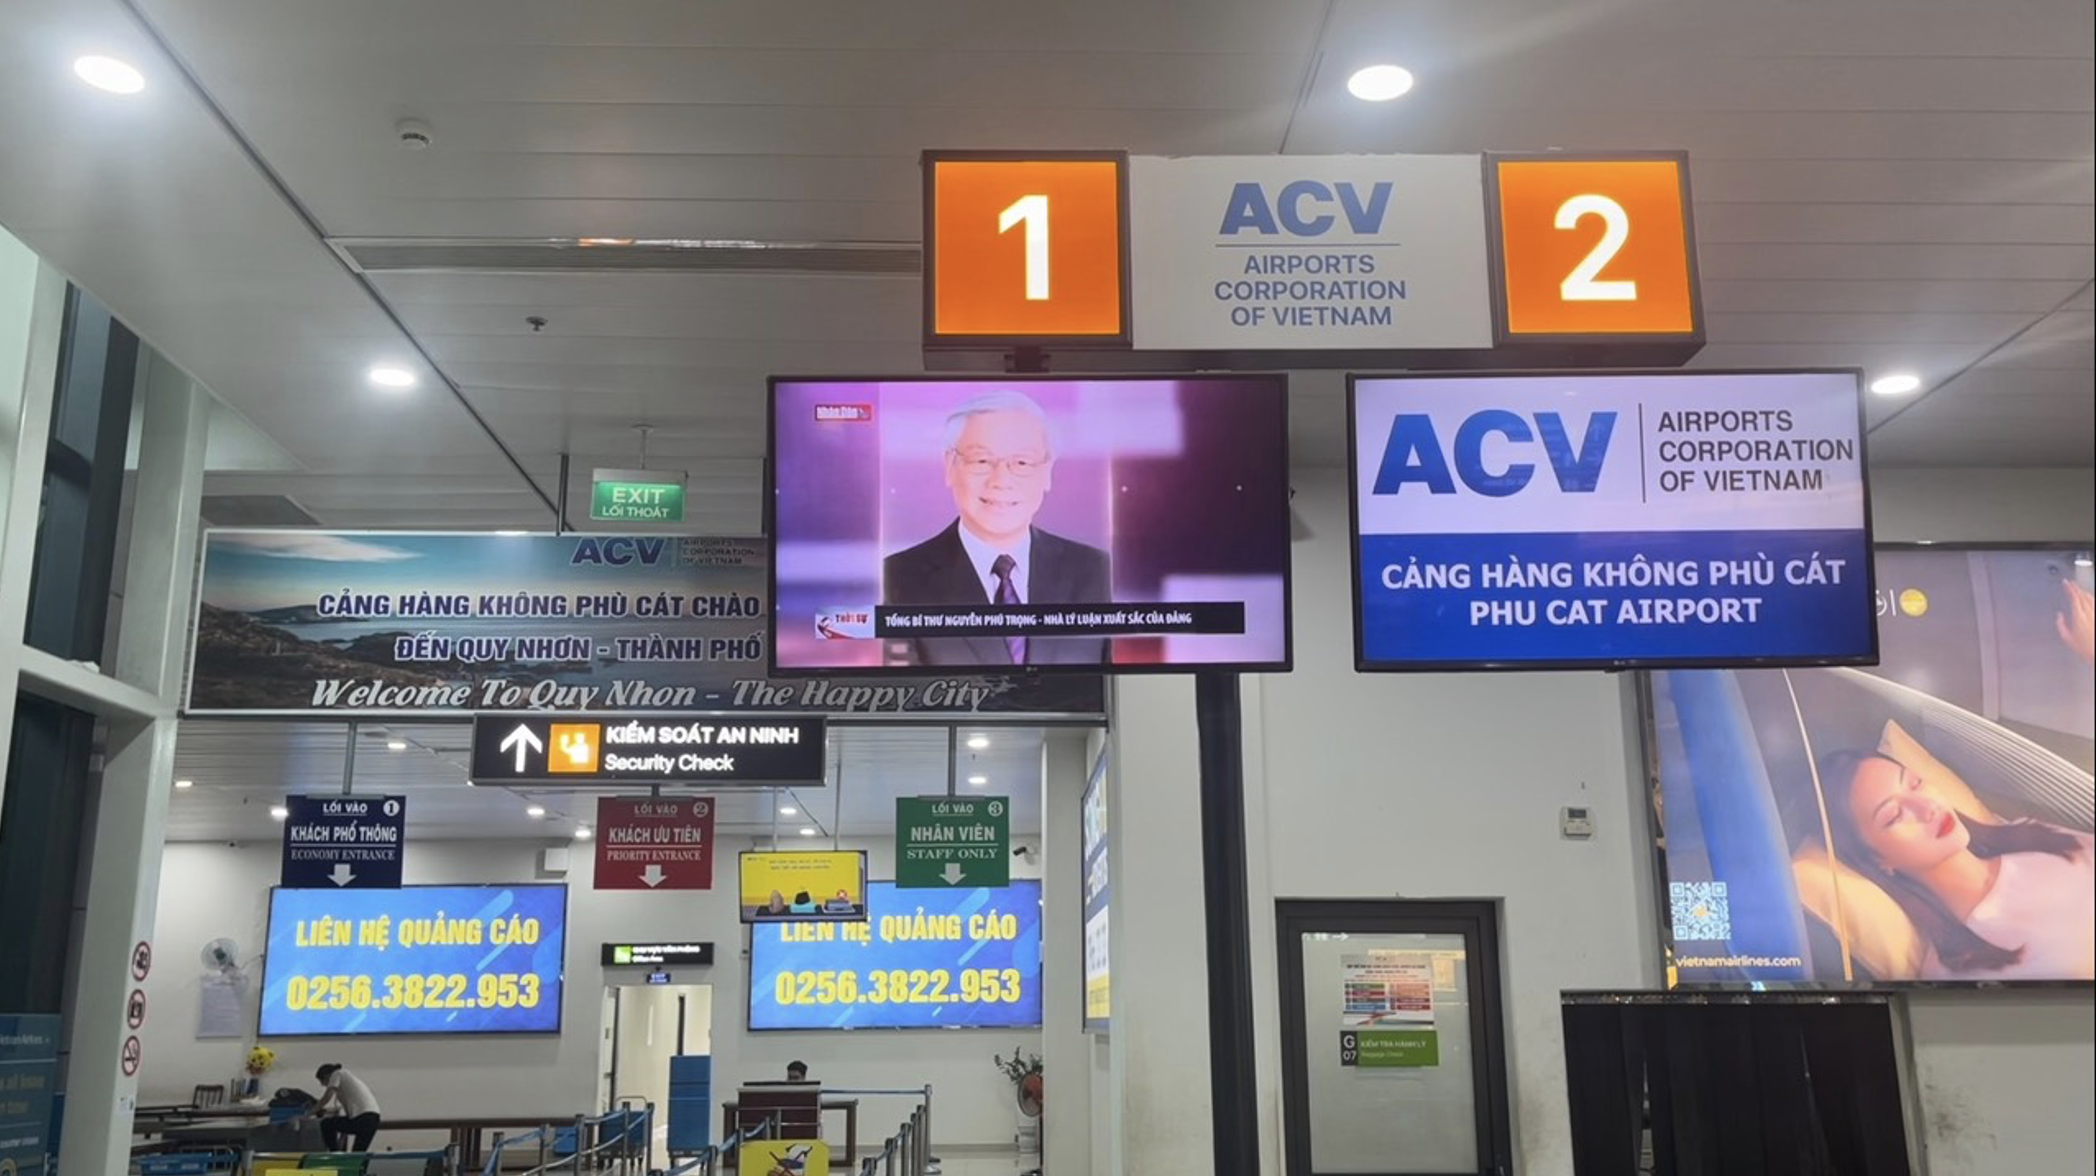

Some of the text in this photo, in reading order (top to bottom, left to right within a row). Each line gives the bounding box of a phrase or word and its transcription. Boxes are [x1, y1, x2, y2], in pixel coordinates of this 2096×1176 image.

[1219, 180, 1393, 236] ACV
[998, 194, 1049, 300] 1
[1553, 194, 1637, 301] 2
[1243, 254, 1375, 275] AIRPORTS
[1214, 279, 1406, 301] CORPORATION
[1230, 304, 1392, 326] OF VIETNAM
[1658, 410, 1793, 433] AIRPORTS
[1372, 409, 1618, 497] ACV
[1659, 439, 1853, 462] CORPORATION
[1660, 469, 1823, 492] OF VIETNAM
[612, 487, 665, 504] EXIT
[602, 503, 669, 518] LỐI THOÁT
[571, 537, 666, 565] ACV
[1382, 551, 1846, 590] CẢNG HÀNG KHÔNG PHÙ CÁT
[318, 587, 761, 617] CẢNG HÀNG KHÔNG PHÙ CÁT CHÀO
[1470, 597, 1762, 626] PHU CAT AIRPORT
[885, 613, 910, 628] TỔNG
[912, 613, 922, 627] BÍ
[924, 613, 944, 627] THƯ
[945, 612, 982, 627] NGUYỄN
[1006, 612, 1036, 628] TRỌNG
[1044, 612, 1064, 625] NHÀ
[1077, 612, 1101, 627] LUẬN
[1103, 610, 1126, 624] XUẤT
[1128, 610, 1144, 624] SẮC
[1146, 611, 1164, 624] CỦA
[395, 630, 451, 661] ĐẾN
[457, 638, 509, 662] QUY
[516, 637, 590, 660] NHƠN
[616, 633, 701, 660] THÀNH
[708, 630, 766, 660] PHỐ
[312, 679, 472, 707] Welcome
[481, 679, 522, 706] To
[527, 679, 600, 710] Quy
[604, 678, 696, 706] Nhon
[732, 680, 790, 706] The
[799, 680, 915, 712] Happy
[922, 680, 993, 712] City
[605, 721, 800, 744] KIỂM SOÁT AN NINH
[605, 754, 734, 774] Security Check
[323, 799, 368, 813] LỐI VÀO
[291, 822, 330, 841] KHÁCH
[359, 823, 397, 842] THÔNG
[609, 824, 701, 843] KHÁCH ƯU TIÊN
[911, 823, 995, 841] NHÂN VIÊN
[291, 849, 395, 860] ECONOMY ENTRANCE
[607, 850, 701, 861] PRIORITY ENTRANCE
[907, 849, 997, 859] STAFF ONLY
[296, 910, 539, 951] LIÊN HỆ QUẢNG CÁO
[880, 906, 962, 943] QUẢNG
[969, 909, 1017, 940] CÁO
[1676, 955, 1801, 967] vietnamairlines.com
[286, 973, 539, 1010] 0256.3822.953
[775, 968, 1021, 1005] 0256.3822.953
[1343, 1035, 1355, 1048] G
[1343, 1050, 1356, 1061] 07
